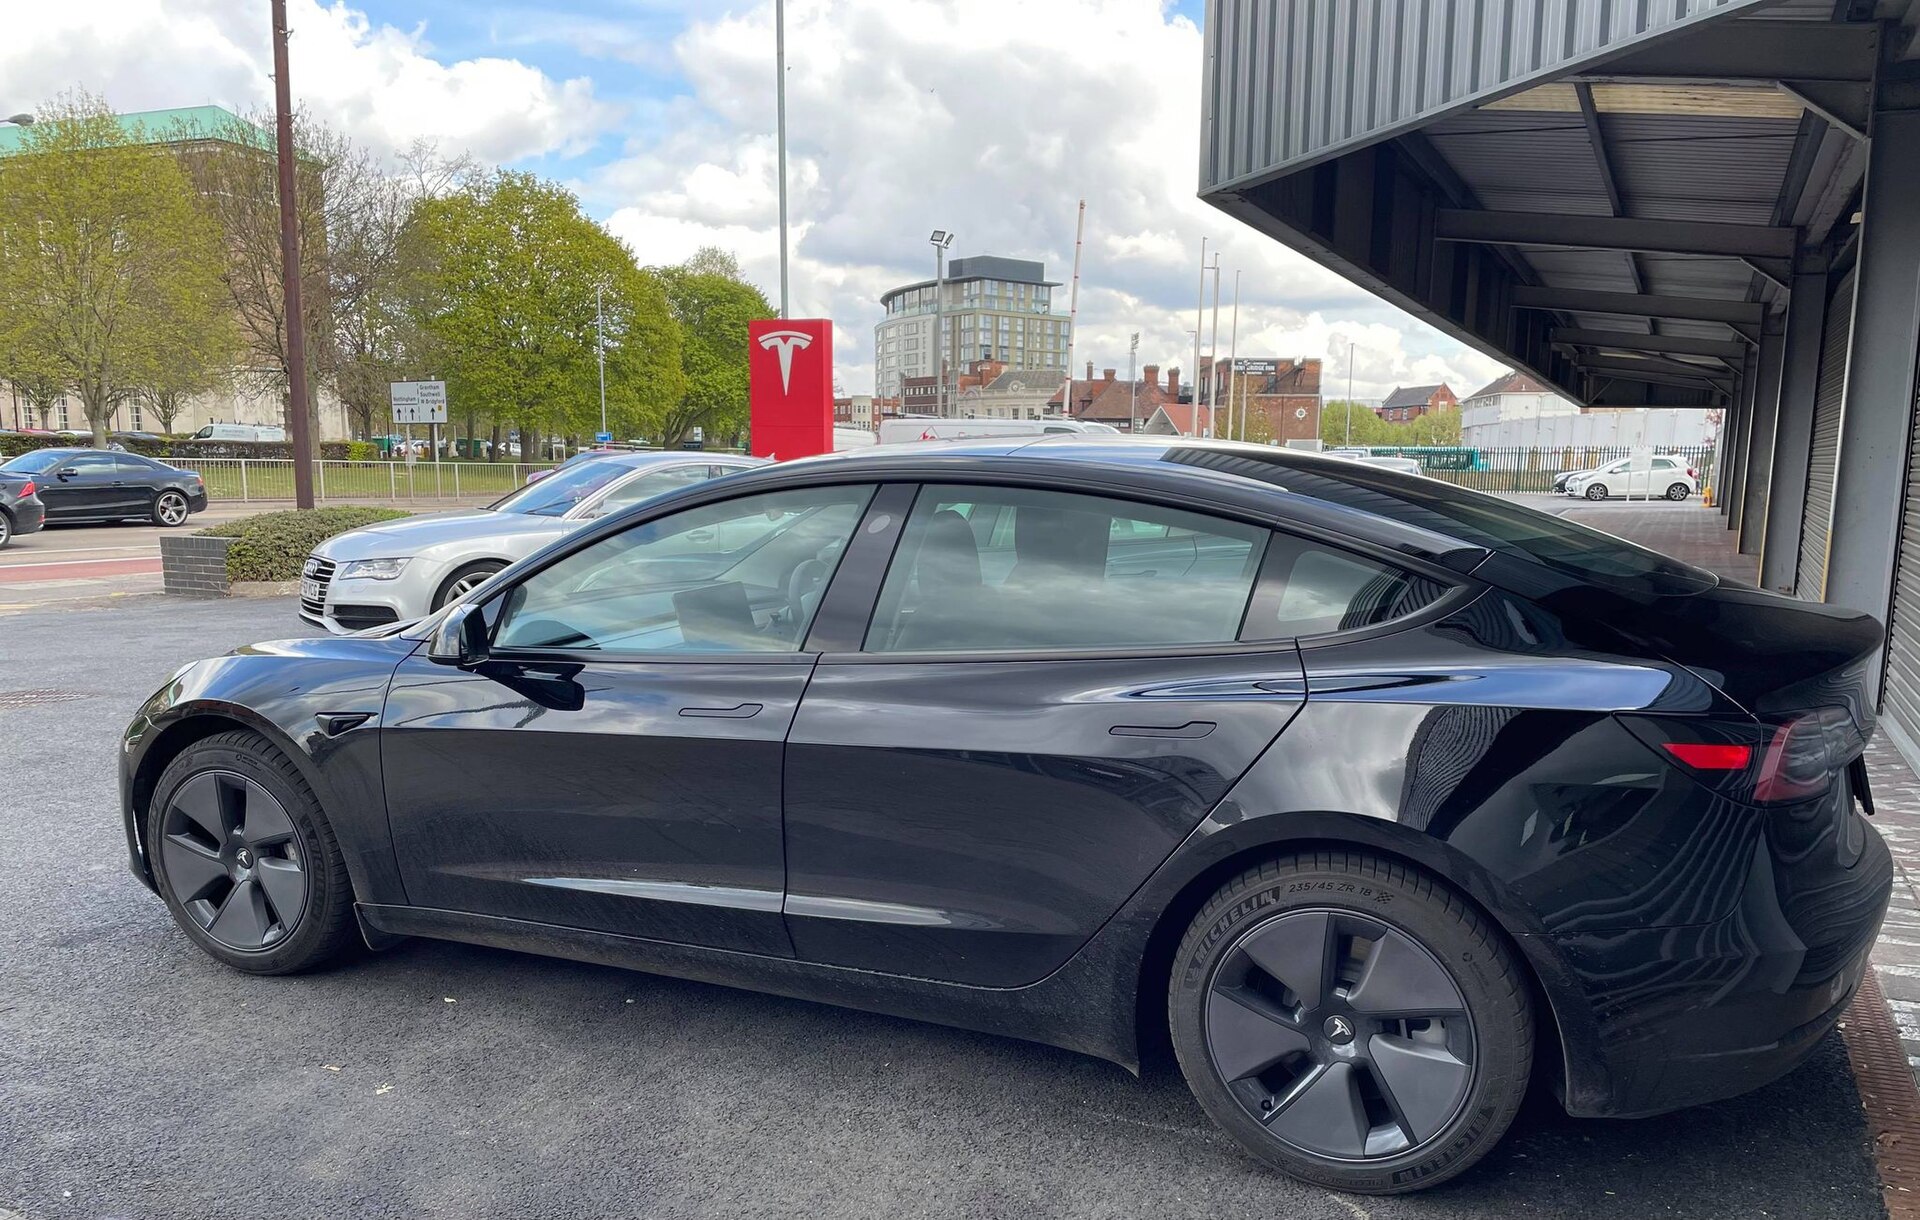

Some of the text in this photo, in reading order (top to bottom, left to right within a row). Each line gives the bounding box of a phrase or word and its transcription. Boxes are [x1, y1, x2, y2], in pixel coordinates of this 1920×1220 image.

[1288, 882, 1373, 897] 235/45 ZR 18
[1195, 889, 1276, 963] MICHELIN
